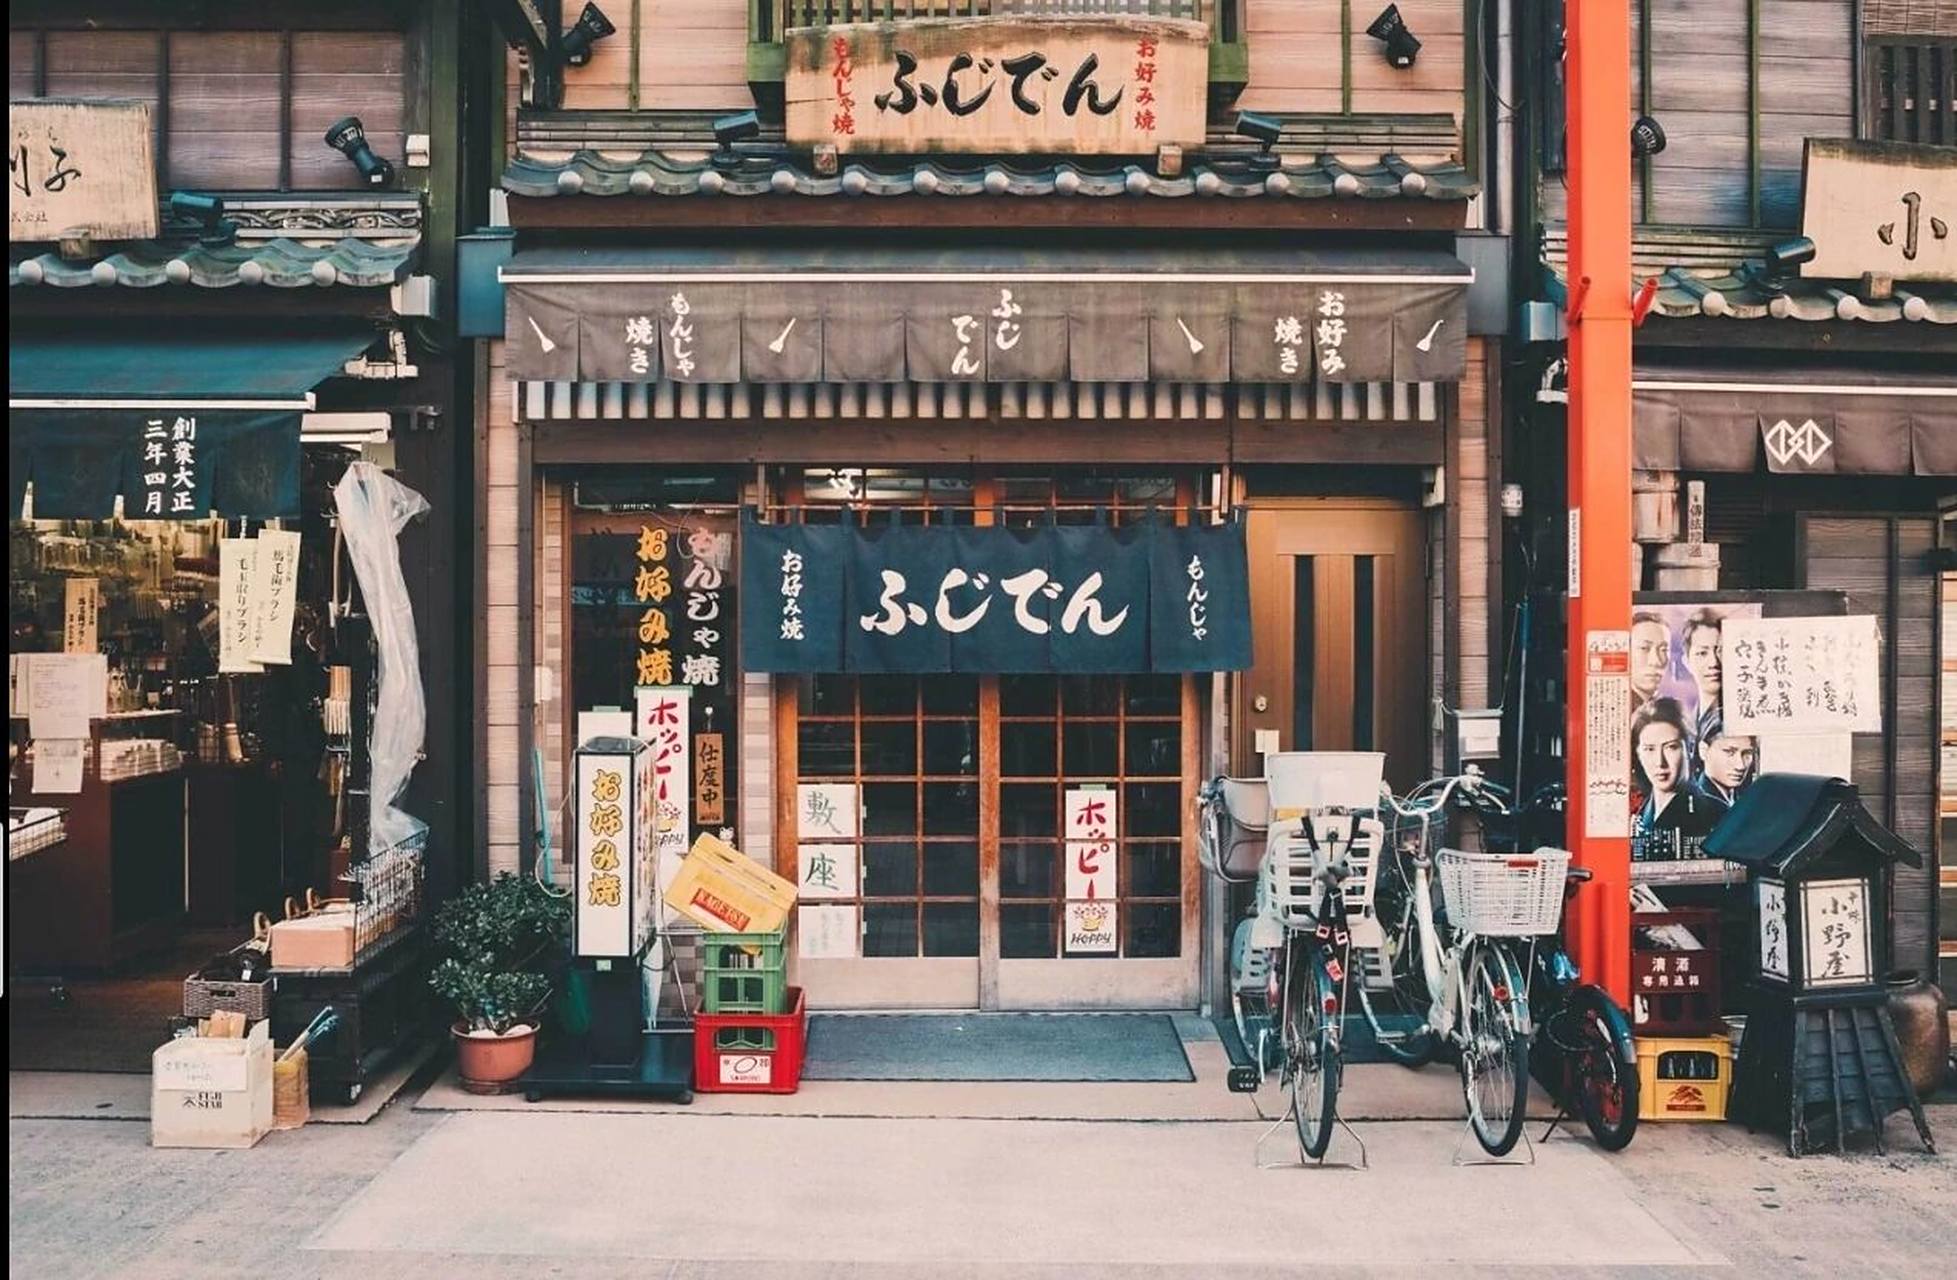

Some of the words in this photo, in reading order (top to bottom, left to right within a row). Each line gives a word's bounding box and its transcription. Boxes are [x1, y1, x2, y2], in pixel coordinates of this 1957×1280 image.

[832, 37, 857, 136] もんじゃ焼
[874, 50, 1125, 117] ふじでん
[1134, 38, 1158, 132] お好み焼
[1877, 191, 1948, 261] 小
[625, 317, 654, 374] 焼き
[670, 292, 696, 378] もんじゃ
[950, 314, 980, 376] でん
[992, 289, 1022, 350] ふじ
[1273, 317, 1303, 375] 焼き
[1317, 290, 1348, 375] お好み
[144, 420, 167, 514] 三年四月
[171, 416, 197, 512] 創業大正
[636, 525, 673, 686] お好み焼
[780, 548, 805, 641] お好み焼
[860, 567, 1130, 637] ふじでん
[1187, 555, 1208, 641] もんじゃ
[648, 696, 681, 800] ホッピー
[698, 741, 721, 808] 仕度中
[589, 768, 622, 906] お好み焼
[655, 832, 684, 847] PPY
[807, 790, 841, 835] 敷
[1075, 797, 1110, 903] ホッピー
[804, 853, 839, 890] 座
[1652, 957, 1690, 972] 清酒
[1821, 897, 1851, 978] 小野屋
